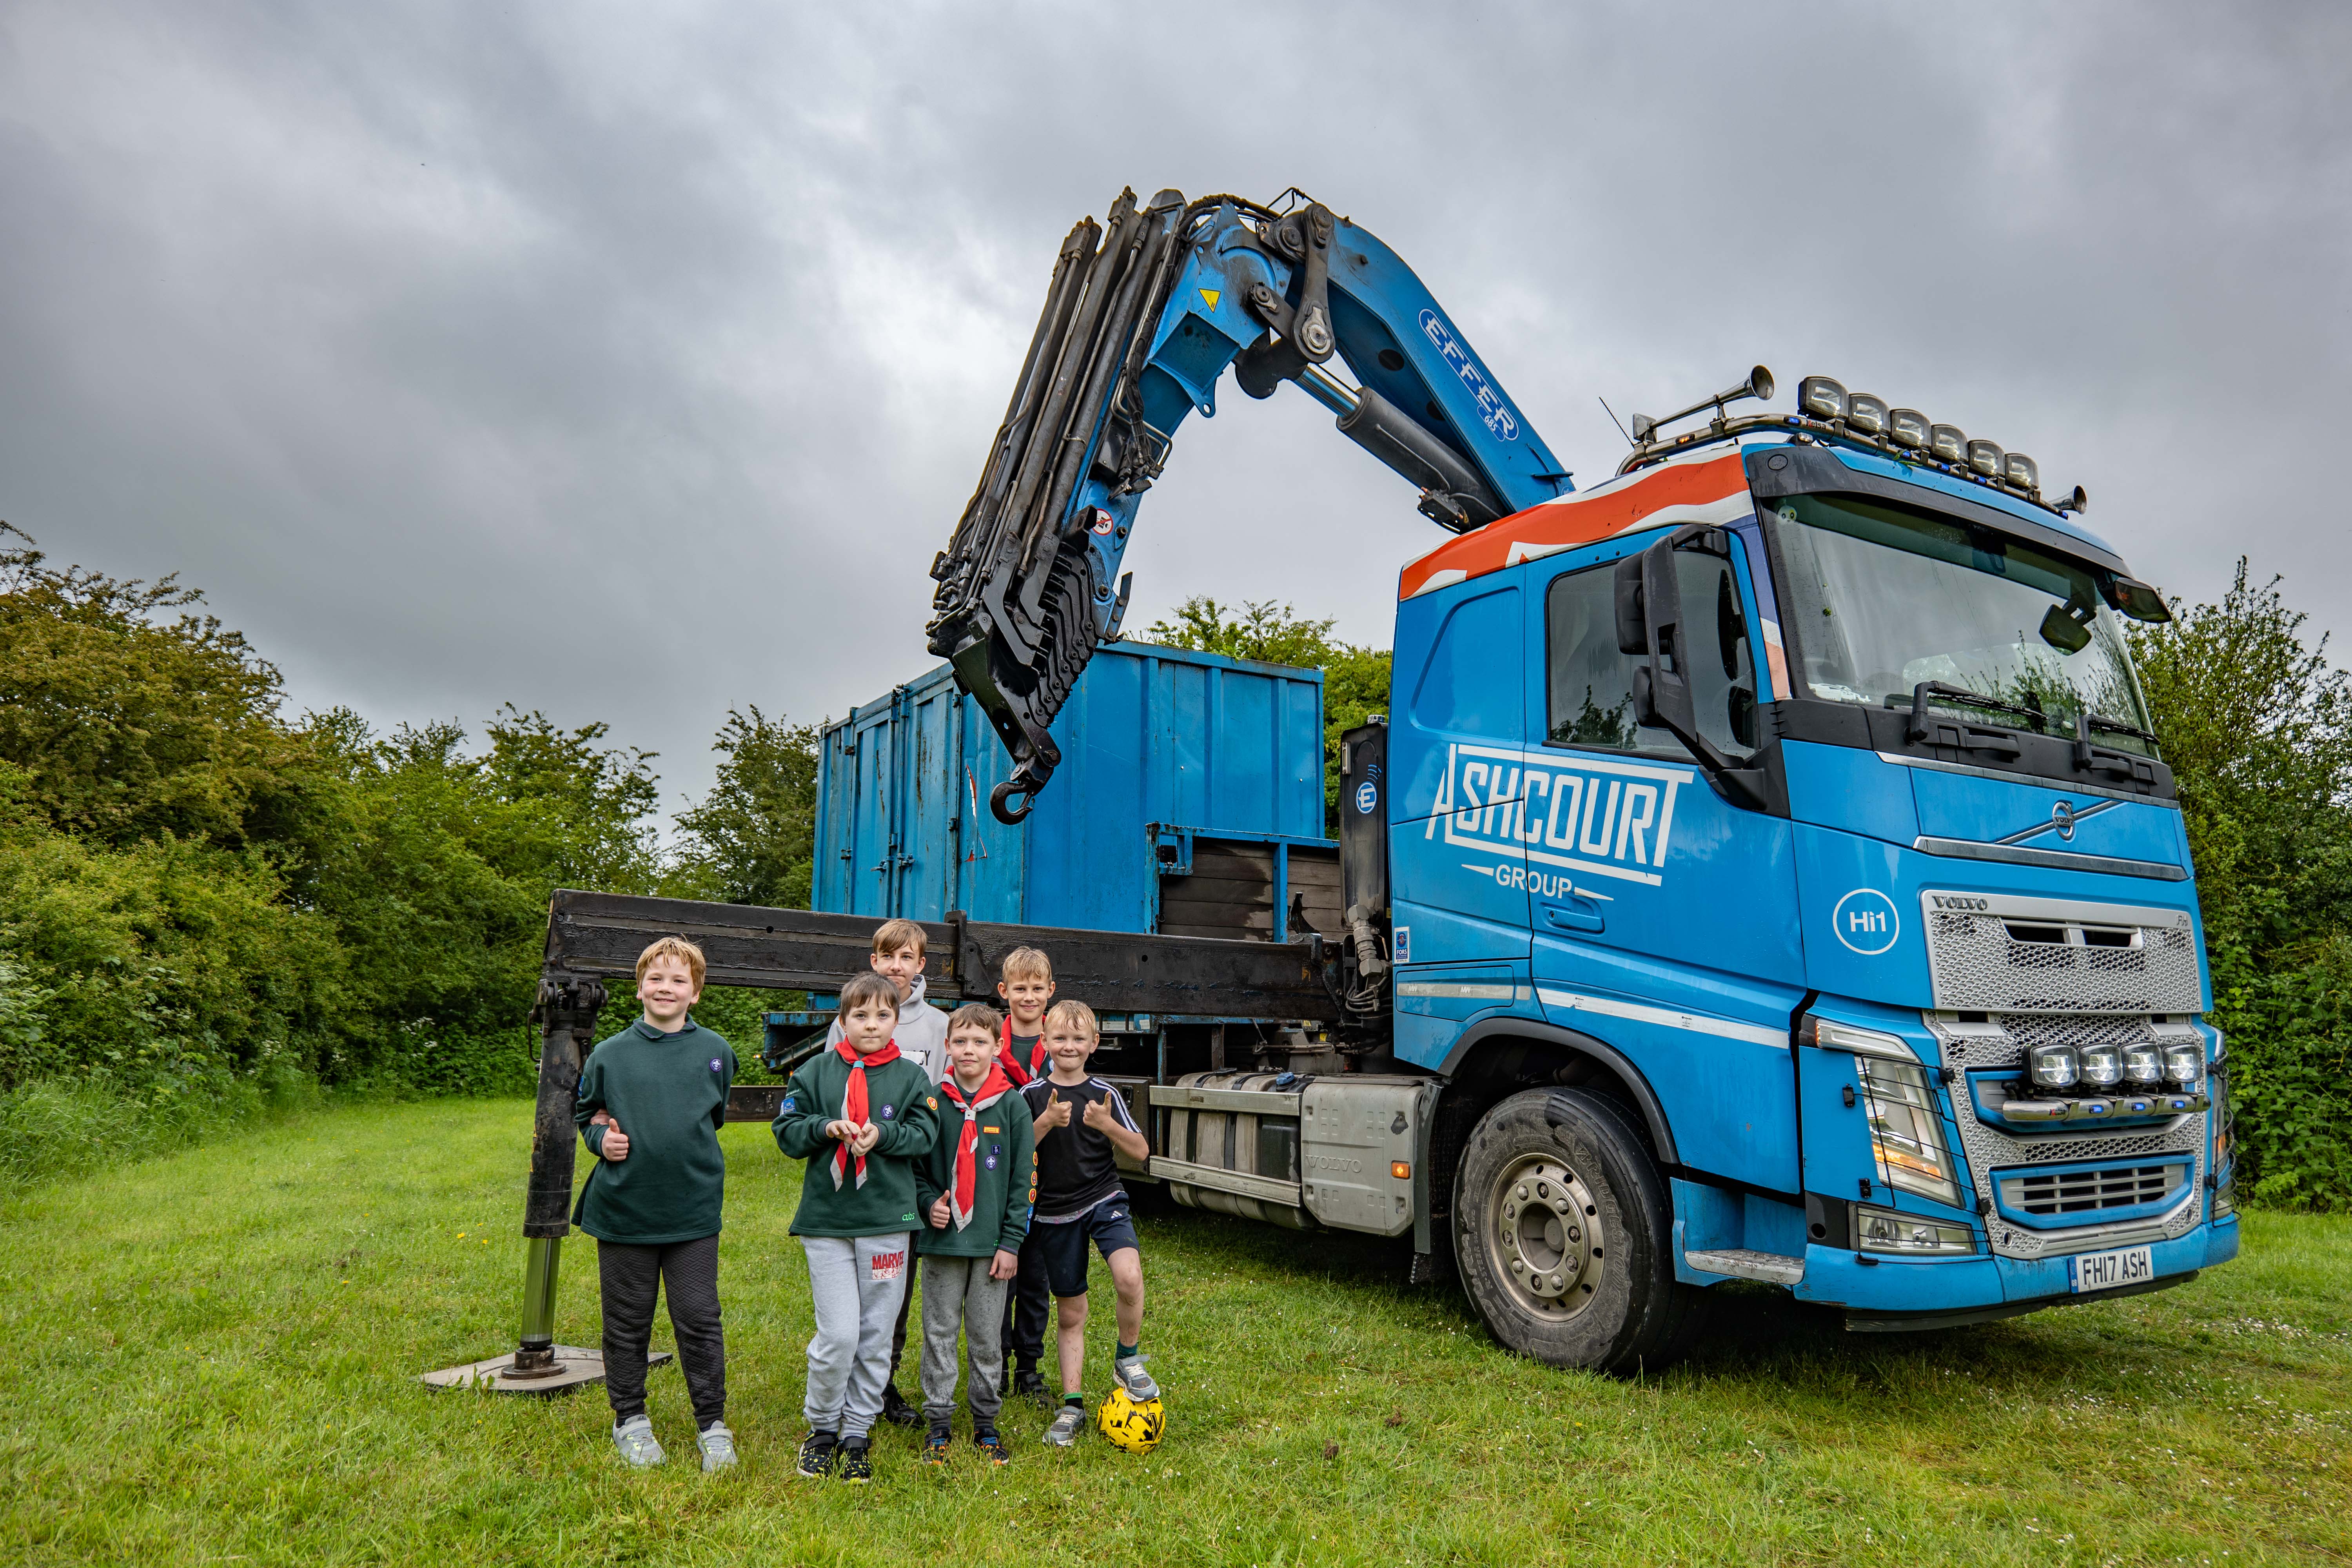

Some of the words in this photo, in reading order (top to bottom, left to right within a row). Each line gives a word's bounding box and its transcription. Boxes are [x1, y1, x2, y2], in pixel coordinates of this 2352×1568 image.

[1425, 317, 1514, 436] EFFER
[1484, 415, 1498, 432] 685
[1425, 743, 1694, 886] ASHCOURT
[1495, 864, 1572, 899] GROUP
[1932, 895, 1988, 911] VOLVO
[1849, 911, 1886, 932] Hi1
[1306, 1154, 1362, 1173] VOLVO
[902, 1211, 915, 1221] cubs
[2082, 1255, 2116, 1285] FH17
[2122, 1251, 2148, 1280] ASH
